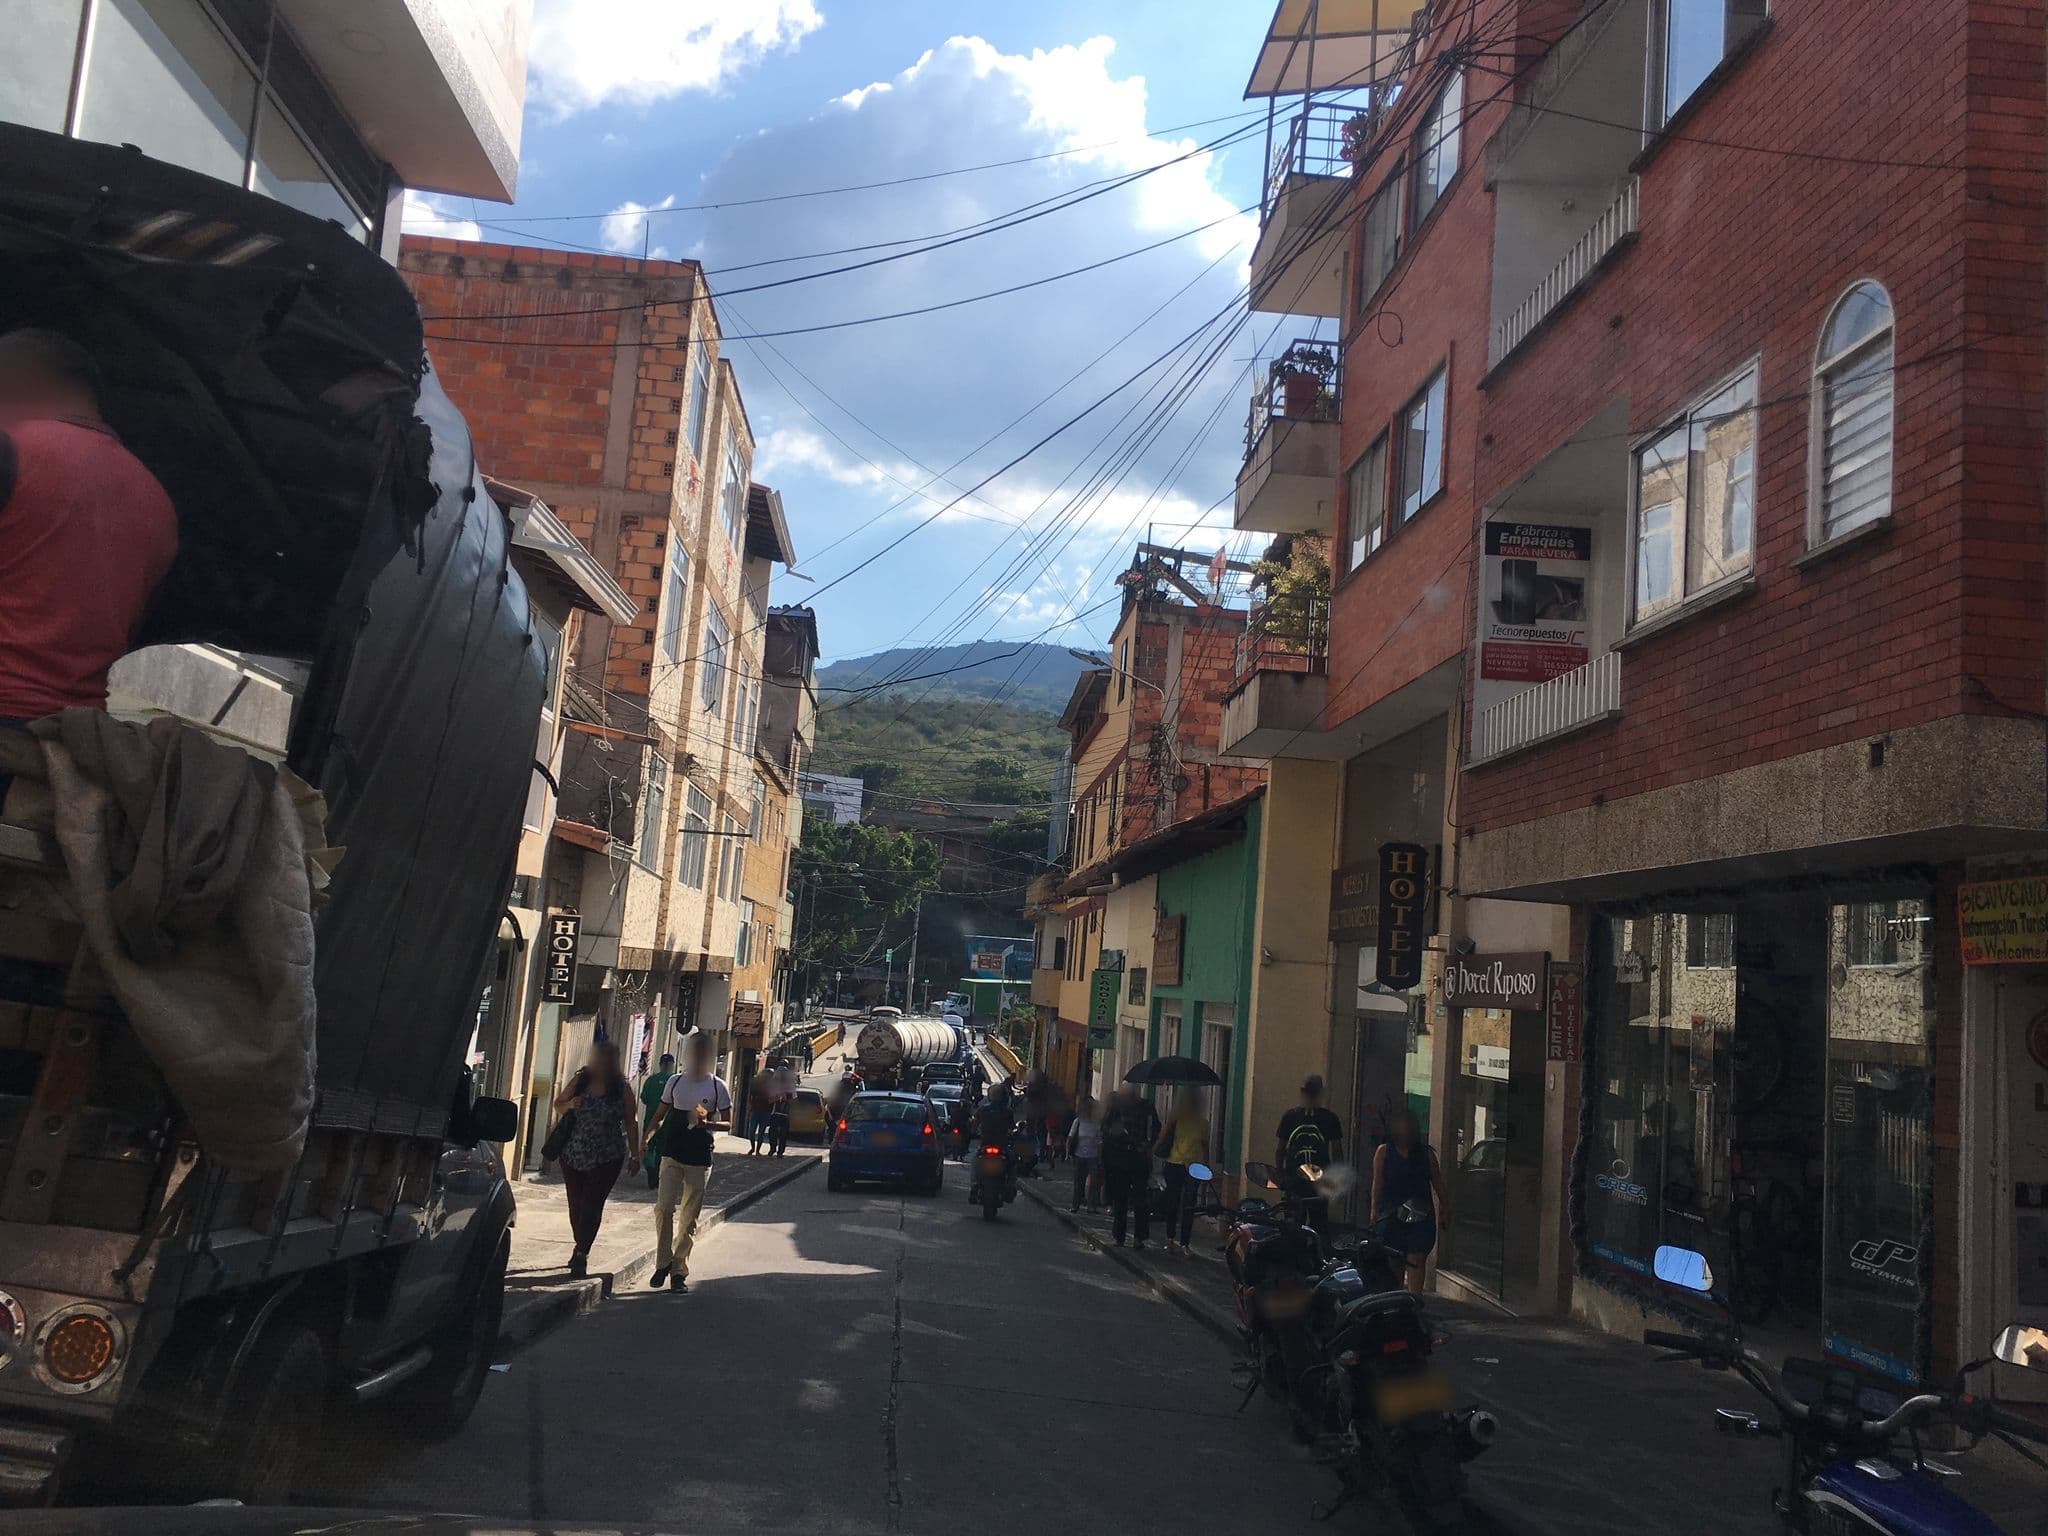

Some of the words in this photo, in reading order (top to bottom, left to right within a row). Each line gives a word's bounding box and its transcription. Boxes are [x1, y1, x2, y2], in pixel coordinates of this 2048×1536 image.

[1499, 532, 1575, 548] Empaques
[1514, 525, 1558, 538] Fabrica
[1499, 546, 1529, 556] PARA
[1531, 548, 1577, 559] NEVERA
[1491, 624, 1567, 640] Tecnorepuestos
[1389, 850, 1416, 979] HOTEL
[548, 920, 576, 998] HOTEL
[1494, 960, 1536, 1002] Riposo
[1550, 974, 1563, 1057] TALLER
[1850, 1261, 1916, 1287] OPTIMUS
